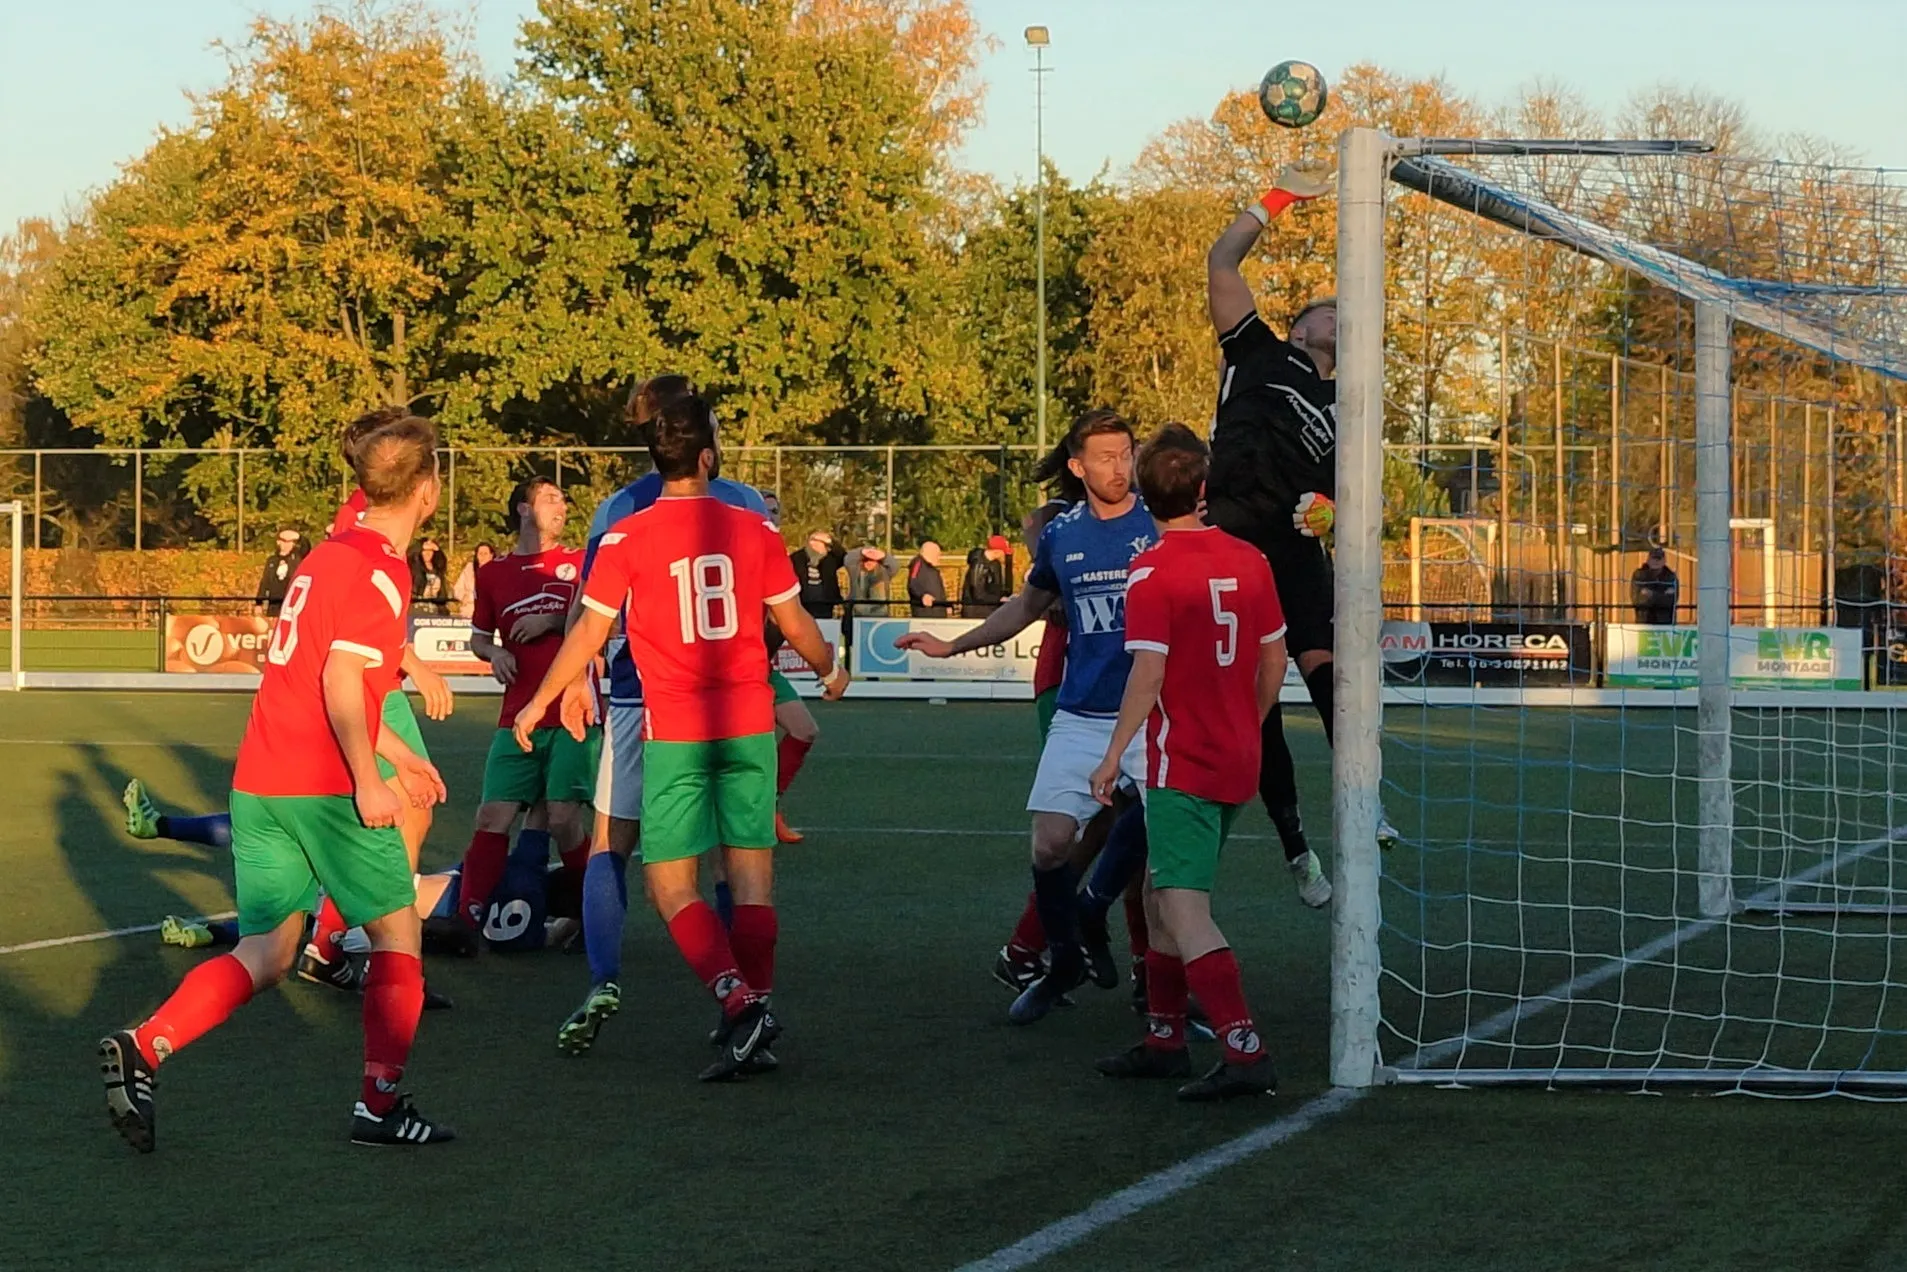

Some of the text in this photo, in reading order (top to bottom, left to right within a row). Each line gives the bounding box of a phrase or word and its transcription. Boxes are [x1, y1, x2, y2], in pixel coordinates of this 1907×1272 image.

[669, 553, 739, 644] 18
[268, 574, 313, 666] 8
[1208, 577, 1238, 667] 5
[1438, 633, 1568, 649] HORECA
[1757, 631, 1832, 660] EVR
[1637, 659, 1698, 670] MONTAG
[1757, 661, 1831, 673] MONTAGE
